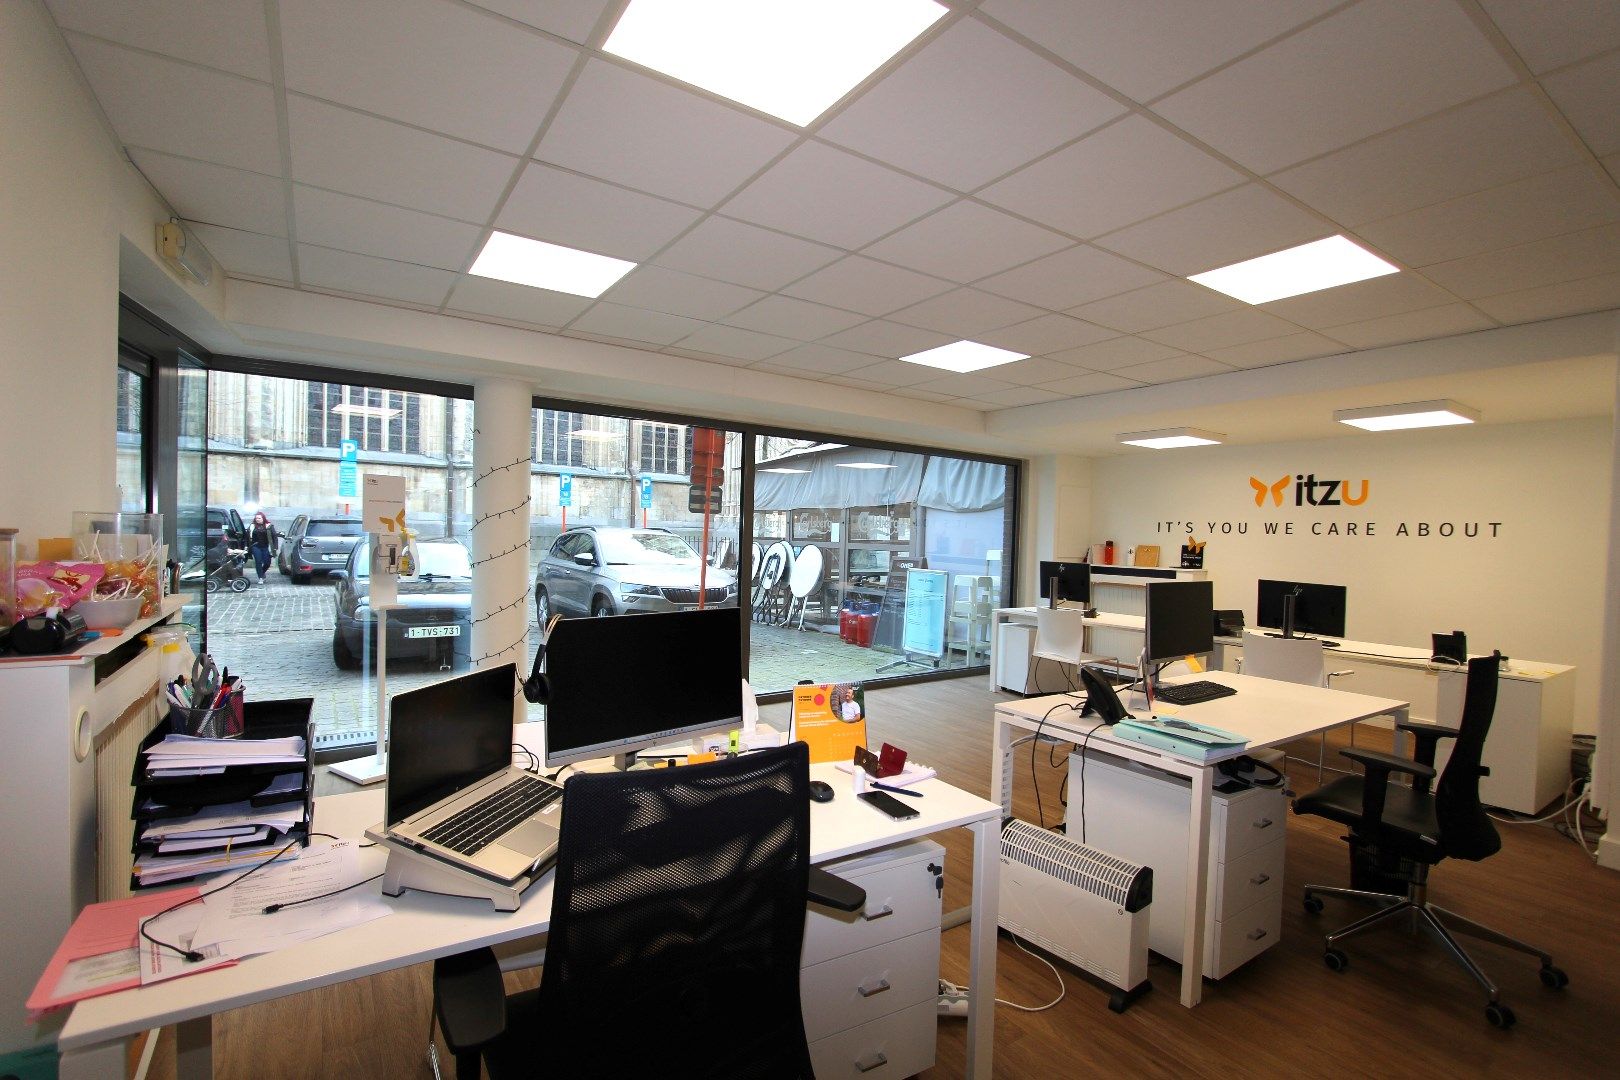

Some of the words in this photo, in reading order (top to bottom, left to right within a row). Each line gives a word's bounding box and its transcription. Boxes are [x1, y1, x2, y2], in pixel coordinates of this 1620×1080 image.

[342, 442, 356, 458] P
[561, 475, 571, 488] P
[642, 478, 651, 491] P
[1157, 521, 1194, 534] IT'S
[1207, 521, 1248, 534] YOU
[1264, 522, 1294, 535] WE
[1311, 522, 1376, 536] CARE
[1396, 522, 1502, 538] ABOUT
[411, 627, 460, 637] 1-TVS-731
